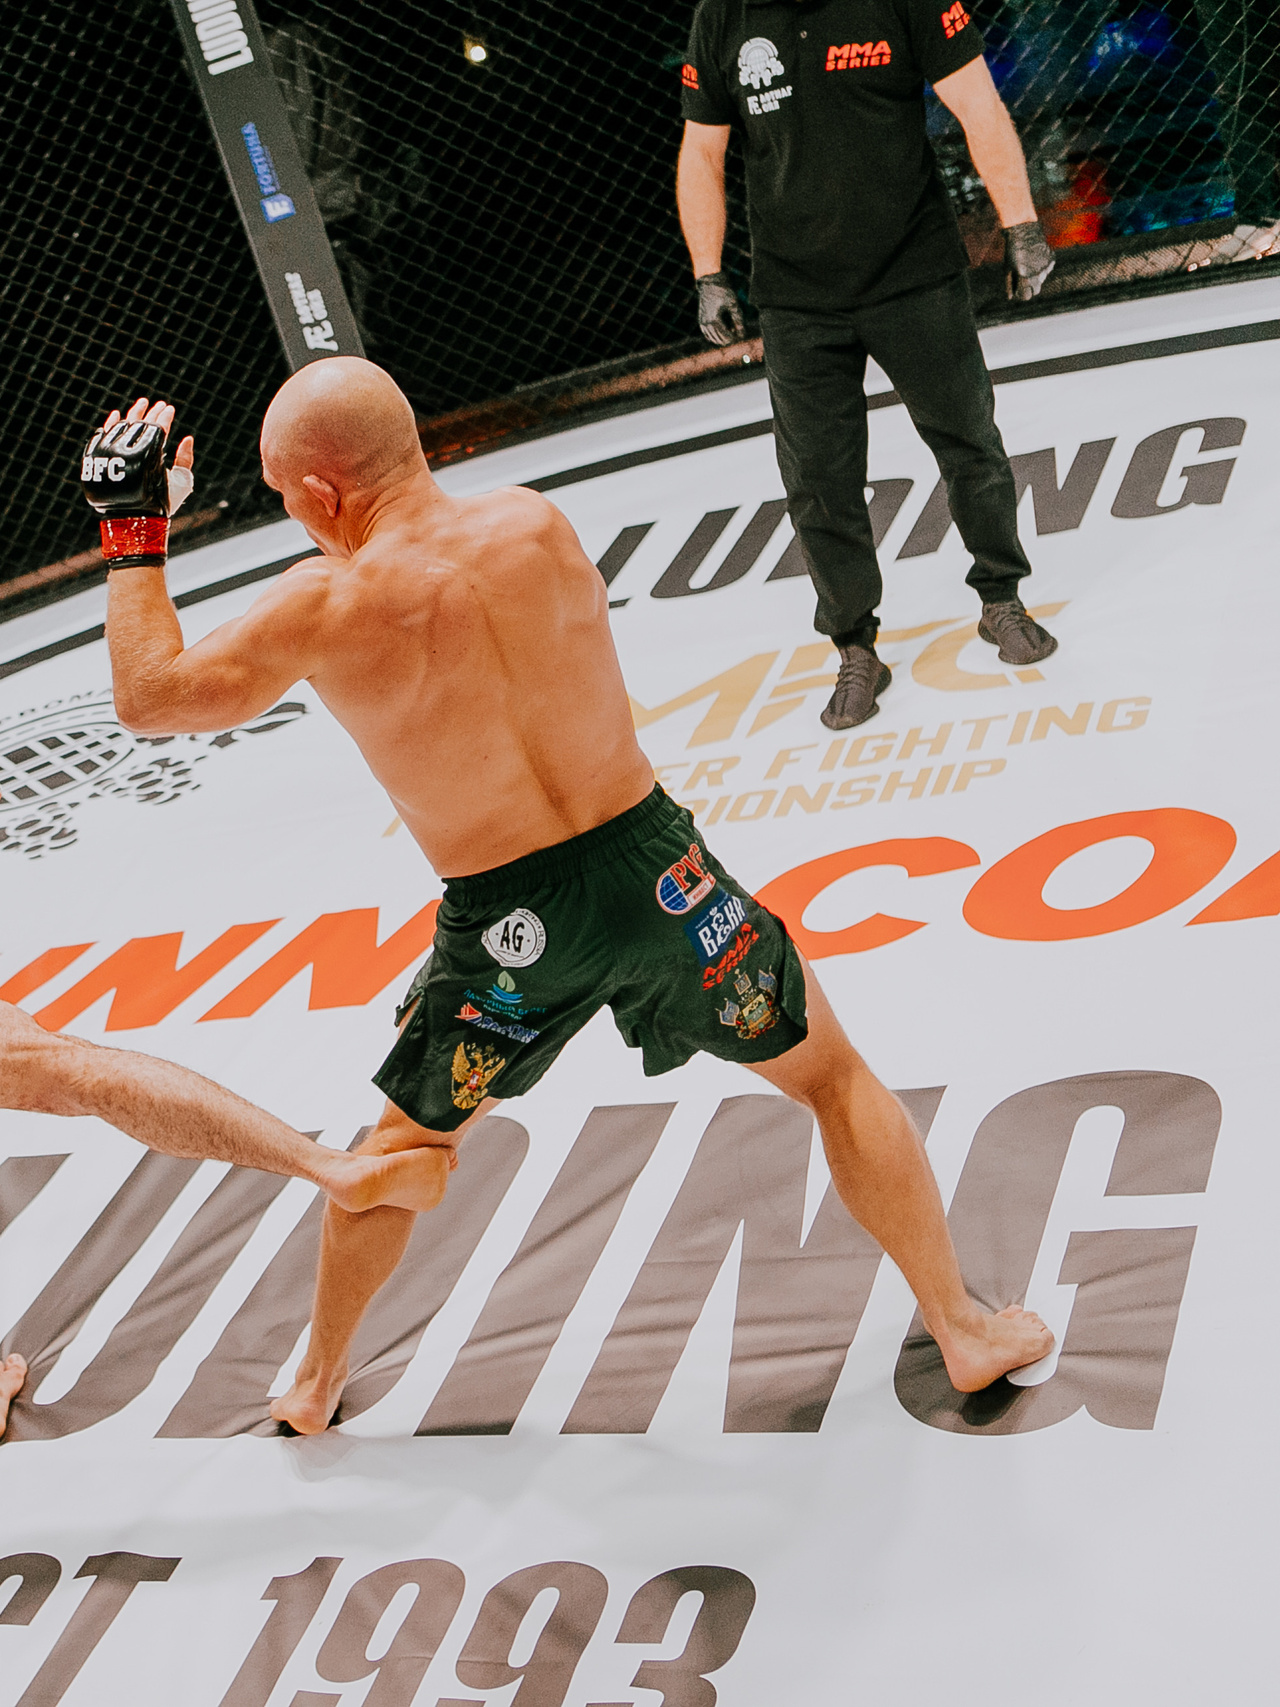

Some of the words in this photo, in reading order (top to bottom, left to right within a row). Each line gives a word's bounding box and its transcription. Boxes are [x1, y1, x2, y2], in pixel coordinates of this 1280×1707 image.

[825, 54, 891, 71] SERIES
[827, 41, 892, 61] MMA
[81, 456, 126, 482] BFC
[763, 696, 1153, 781] FIGHTING
[680, 758, 1008, 828] PIONSHIP
[500, 921, 525, 953] AG
[219, 1556, 757, 1707] 1993
